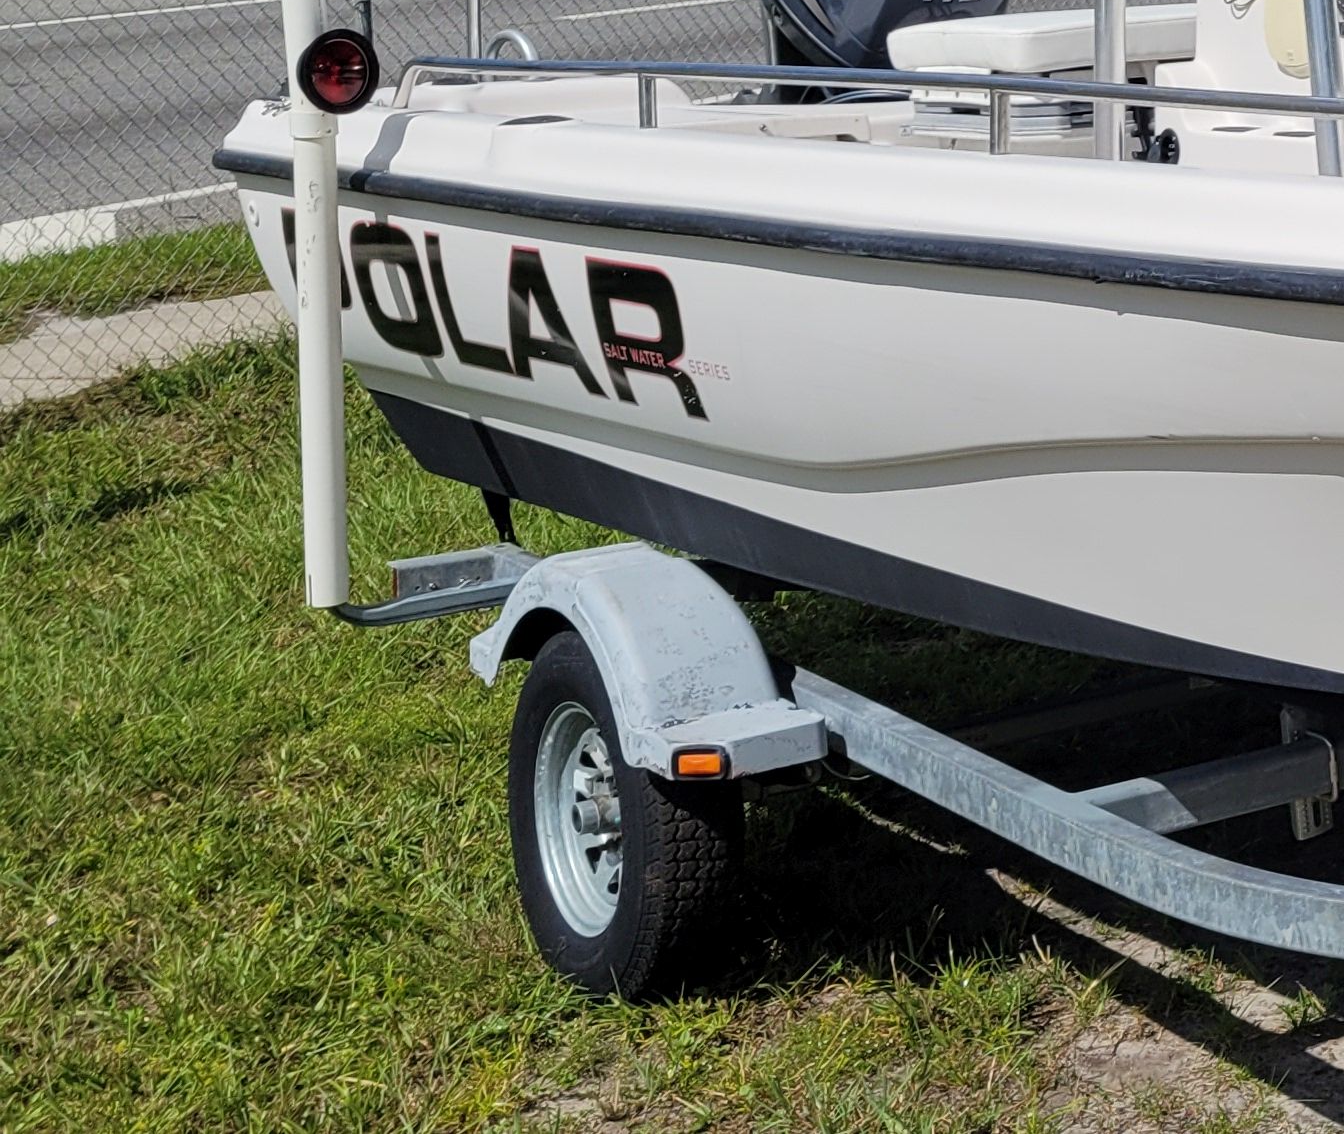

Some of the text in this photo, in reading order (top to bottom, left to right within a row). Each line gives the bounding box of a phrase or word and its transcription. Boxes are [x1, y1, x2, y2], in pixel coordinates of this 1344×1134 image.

[603, 343, 731, 381] SALT WATER SERIES
